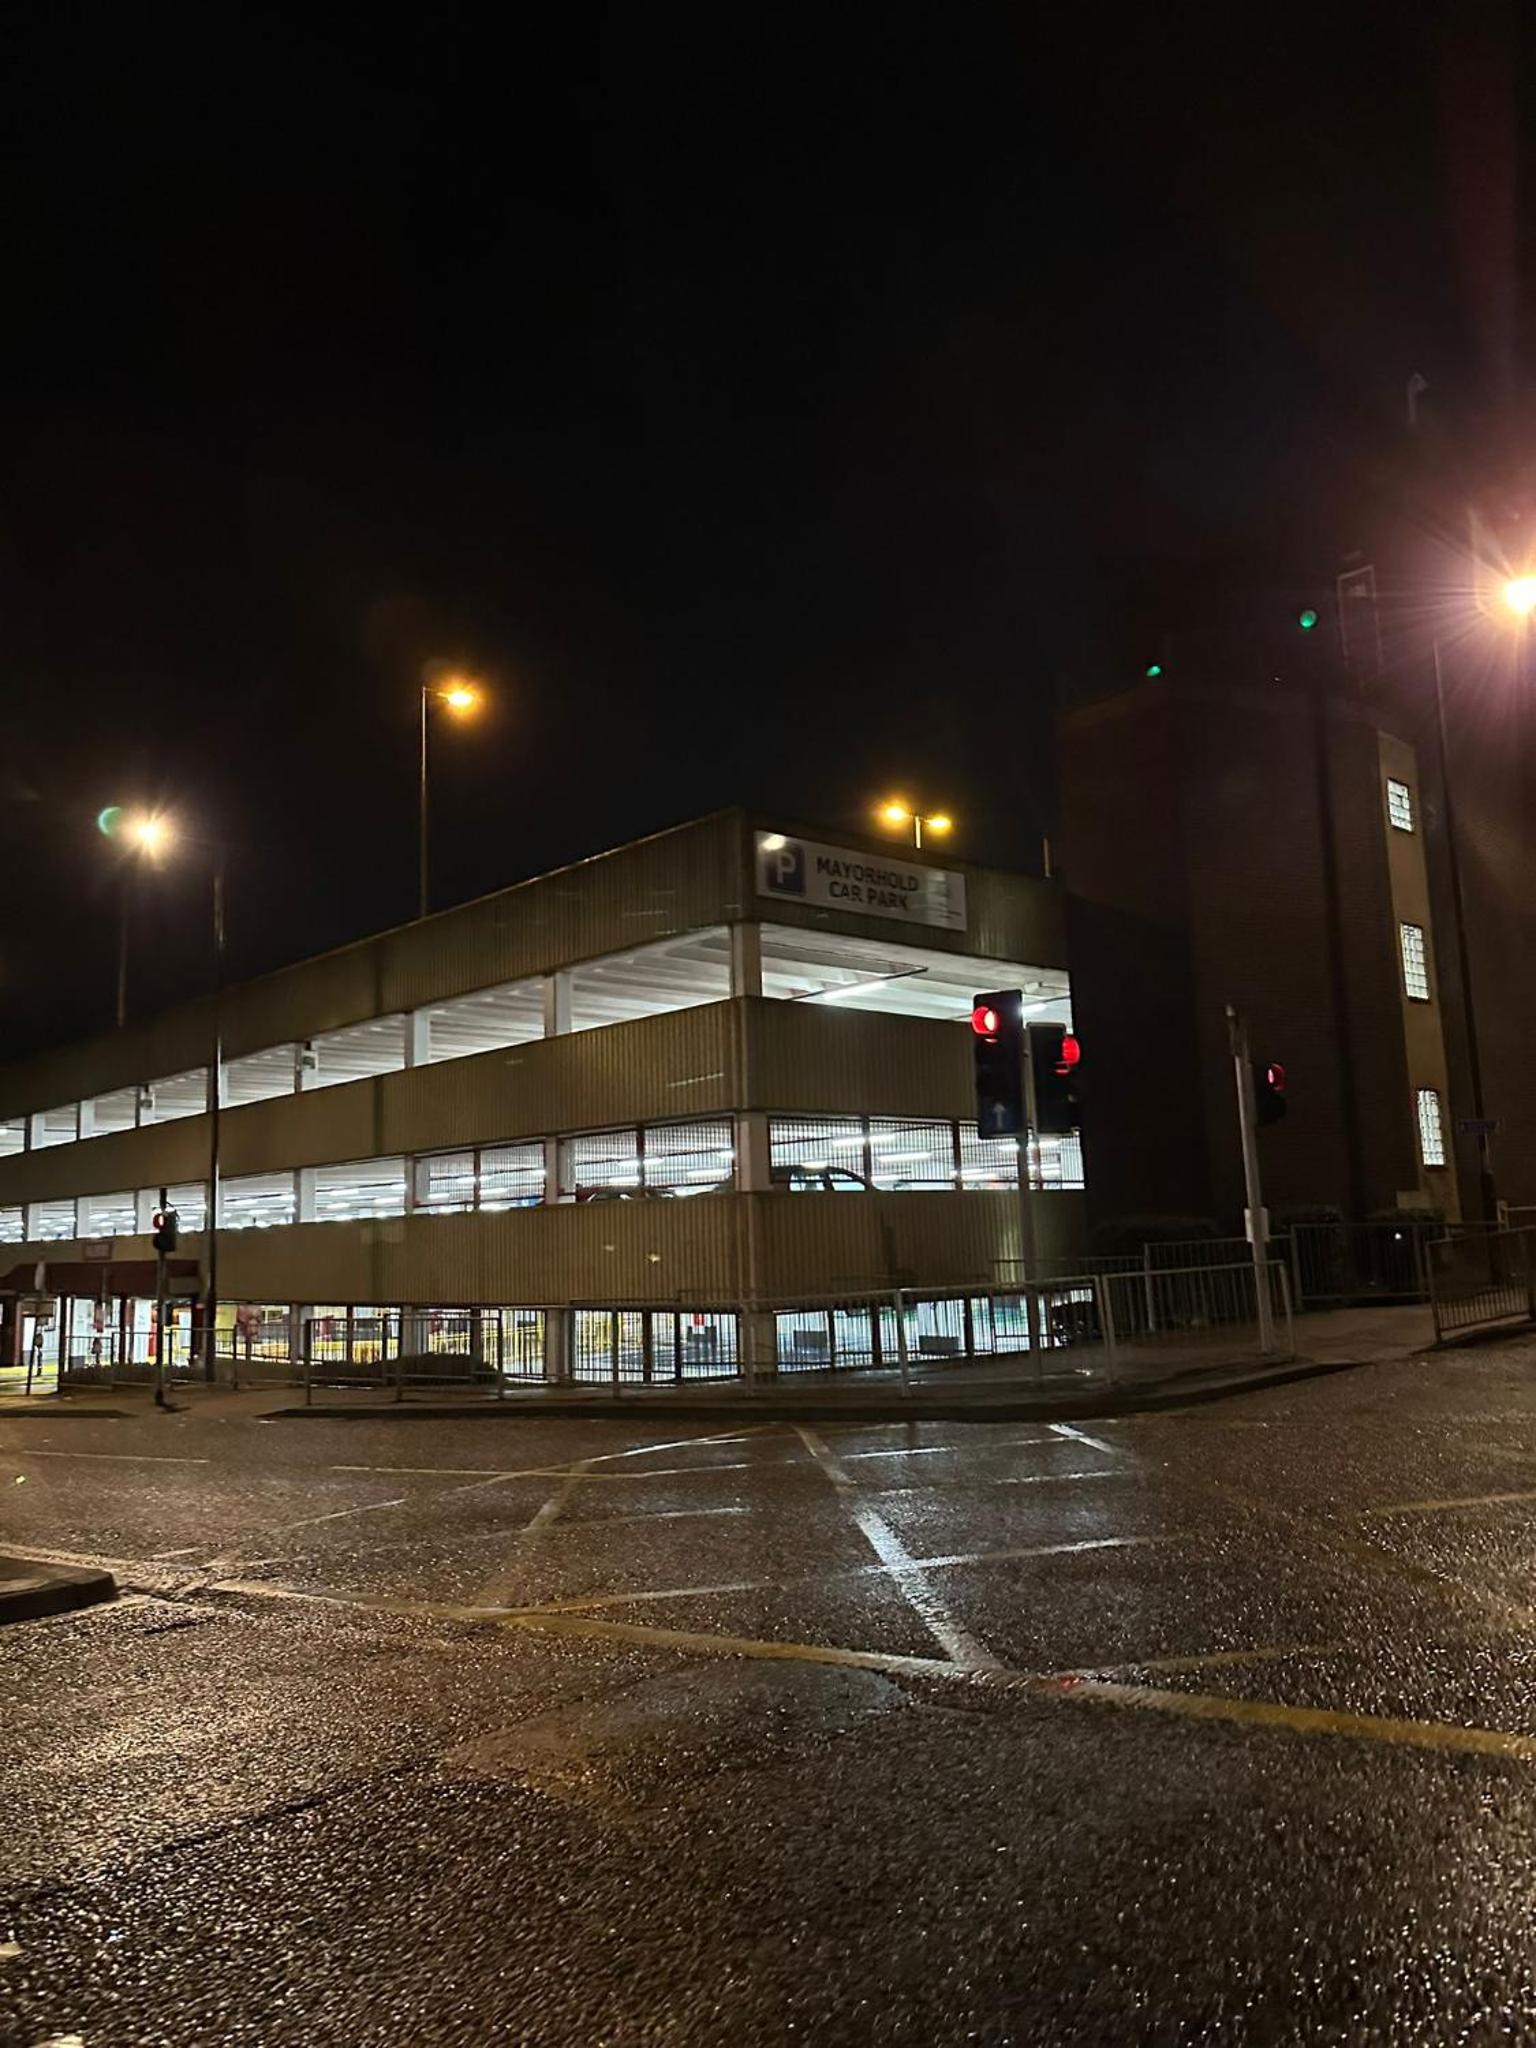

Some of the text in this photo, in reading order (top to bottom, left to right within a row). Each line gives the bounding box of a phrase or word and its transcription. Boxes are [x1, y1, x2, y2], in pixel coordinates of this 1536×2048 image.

[776, 851, 796, 883] P
[816, 857, 919, 891] MAYORHOLD
[829, 880, 908, 911] CAR PARK
